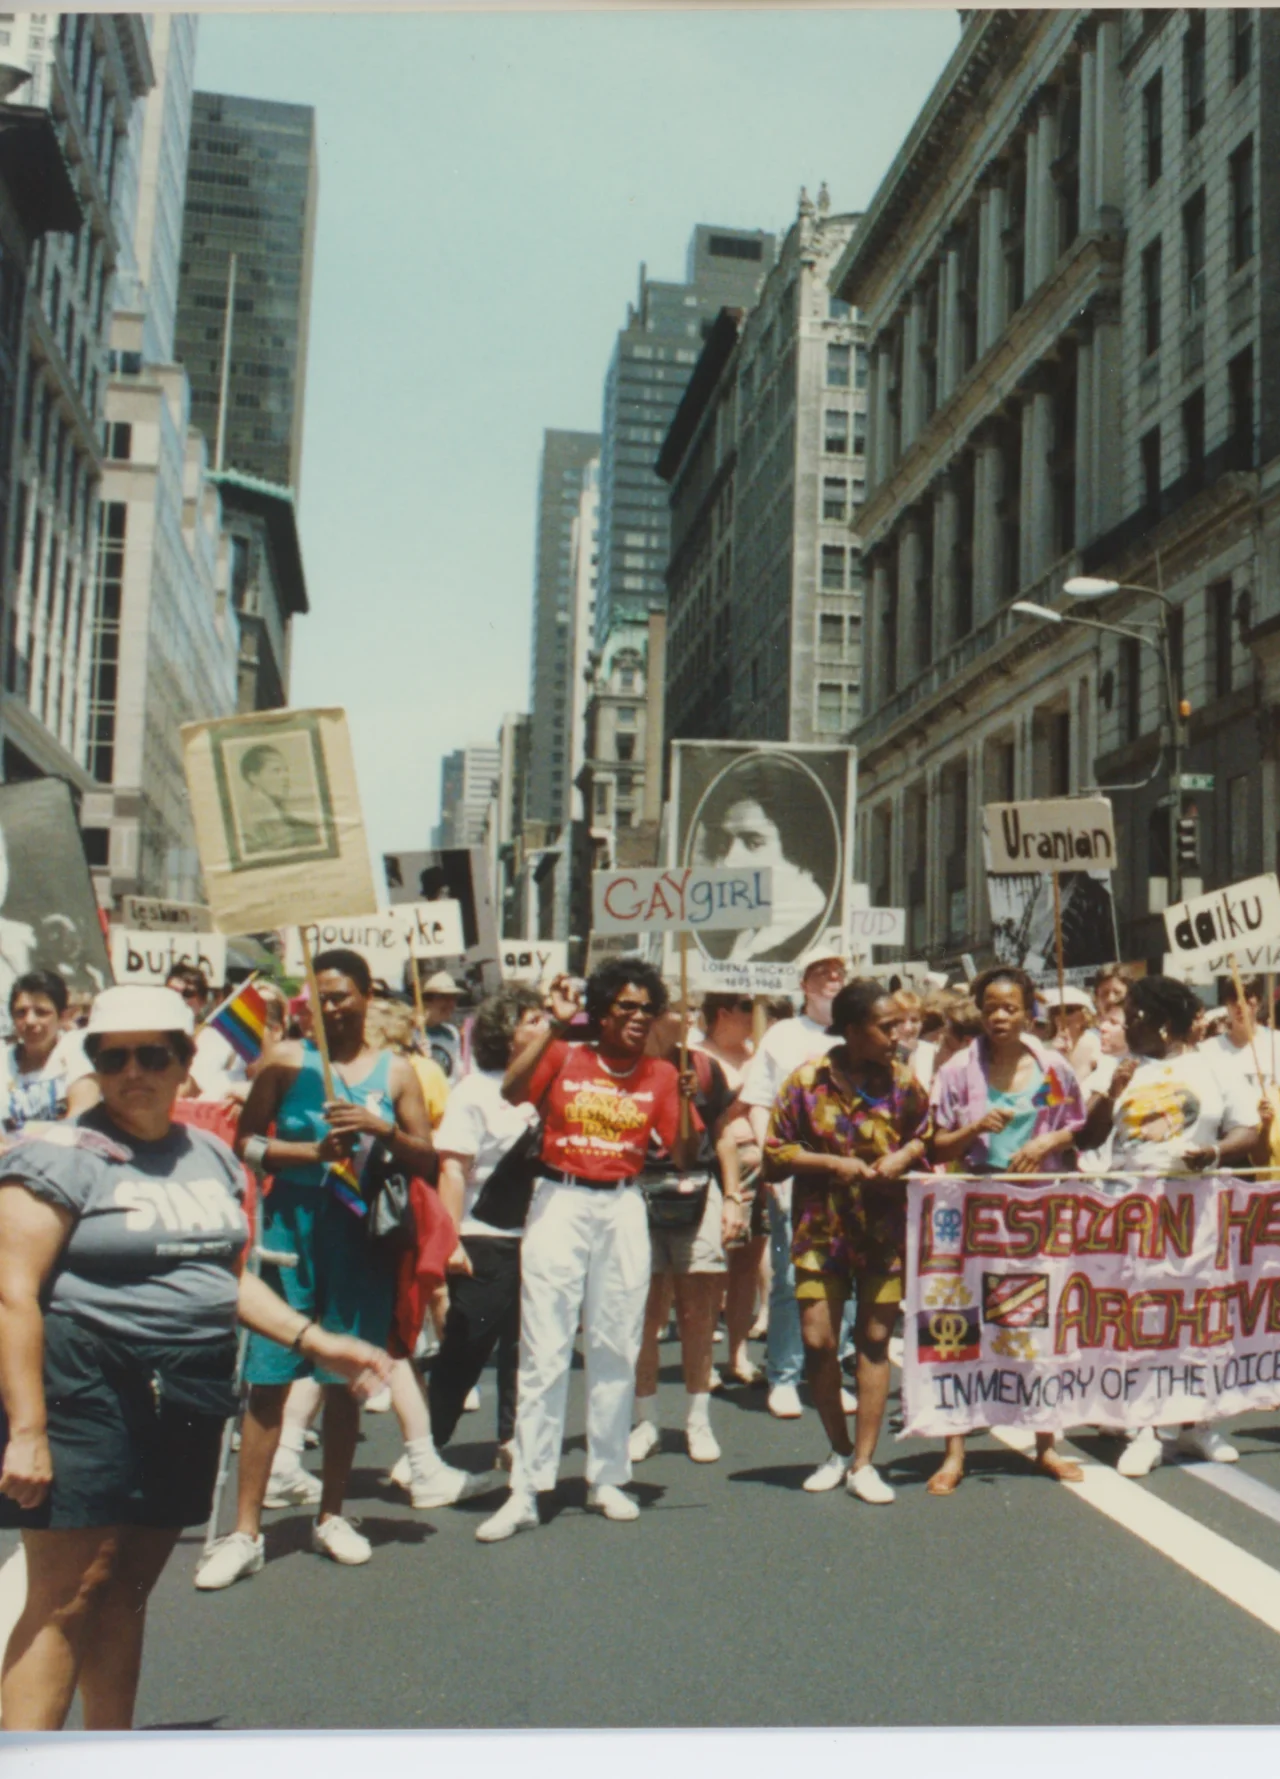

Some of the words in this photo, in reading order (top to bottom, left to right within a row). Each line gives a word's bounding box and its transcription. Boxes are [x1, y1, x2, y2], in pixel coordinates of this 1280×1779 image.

[1002, 808, 1111, 862] Uranian
[850, 911, 897, 936] TUD
[918, 1192, 1194, 1277] LESBIAN
[1101, 1366, 1140, 1400] OF
[1148, 1364, 1208, 1400] THE
